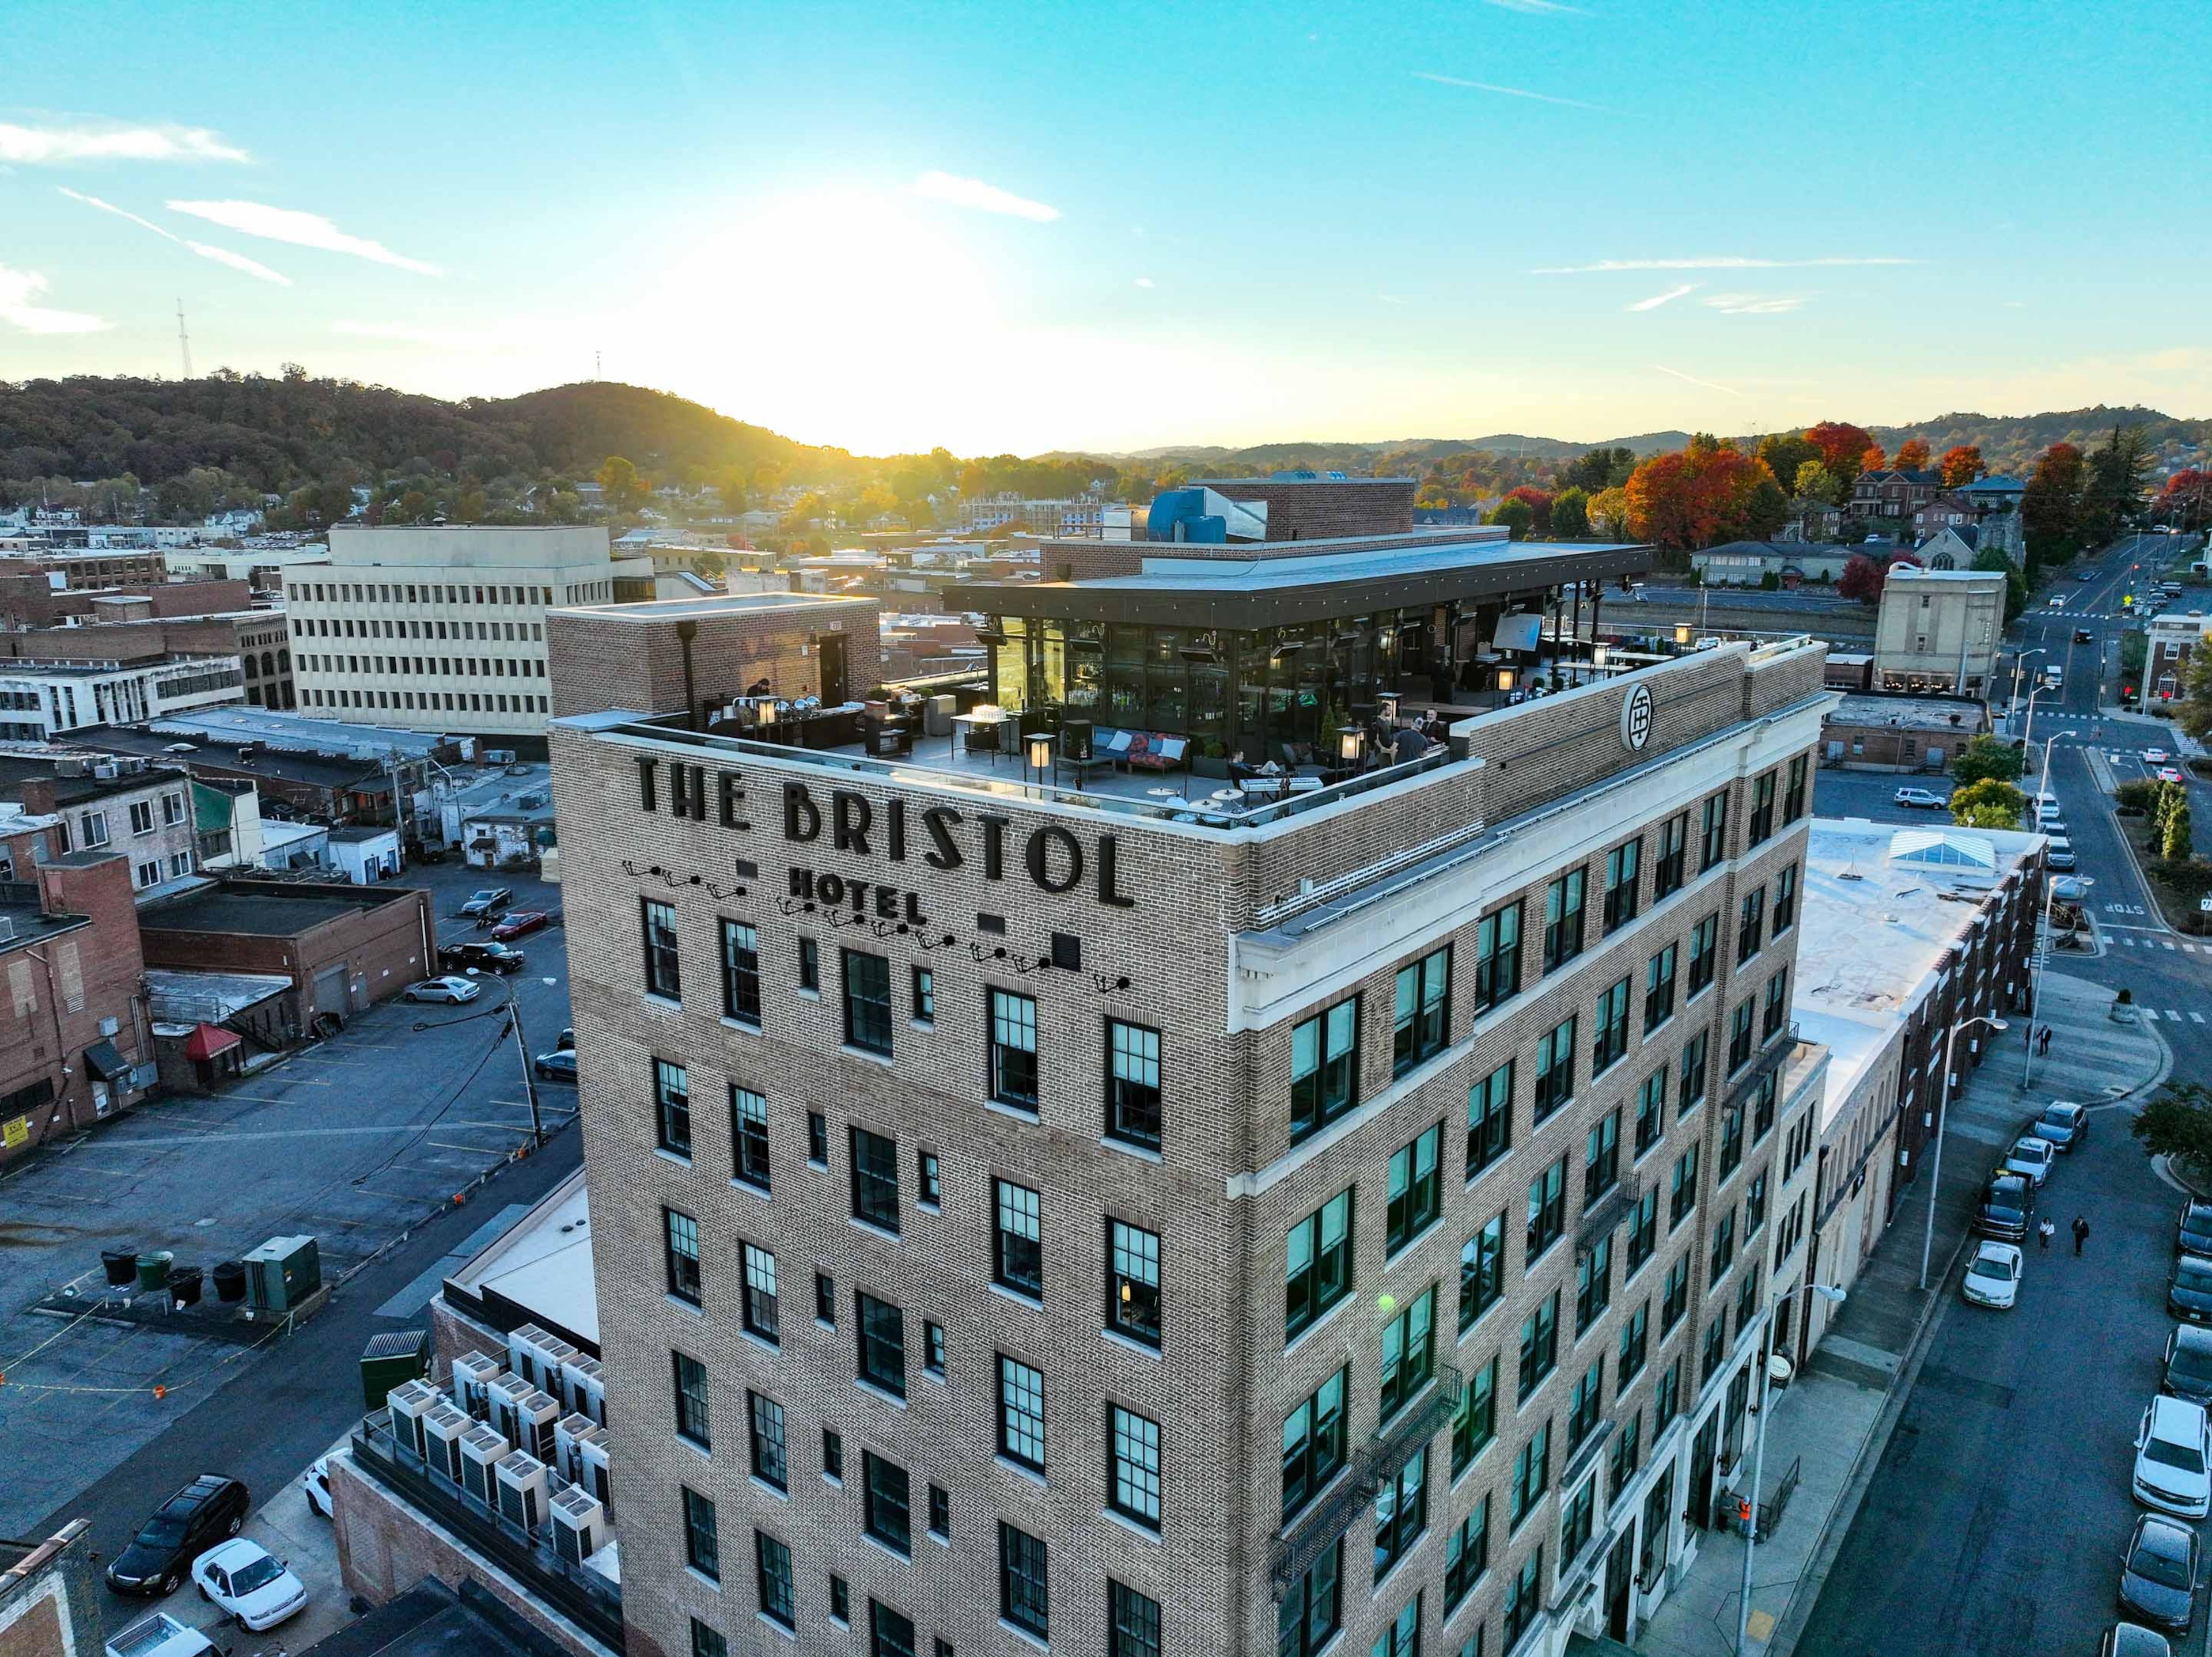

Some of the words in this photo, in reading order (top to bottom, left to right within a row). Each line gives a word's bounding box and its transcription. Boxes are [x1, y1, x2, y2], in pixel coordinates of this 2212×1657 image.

[634, 756, 751, 831] THE
[783, 782, 1135, 907] BRISTOL
[789, 867, 927, 926] HOTEL
[2104, 903, 2145, 915] STOP
